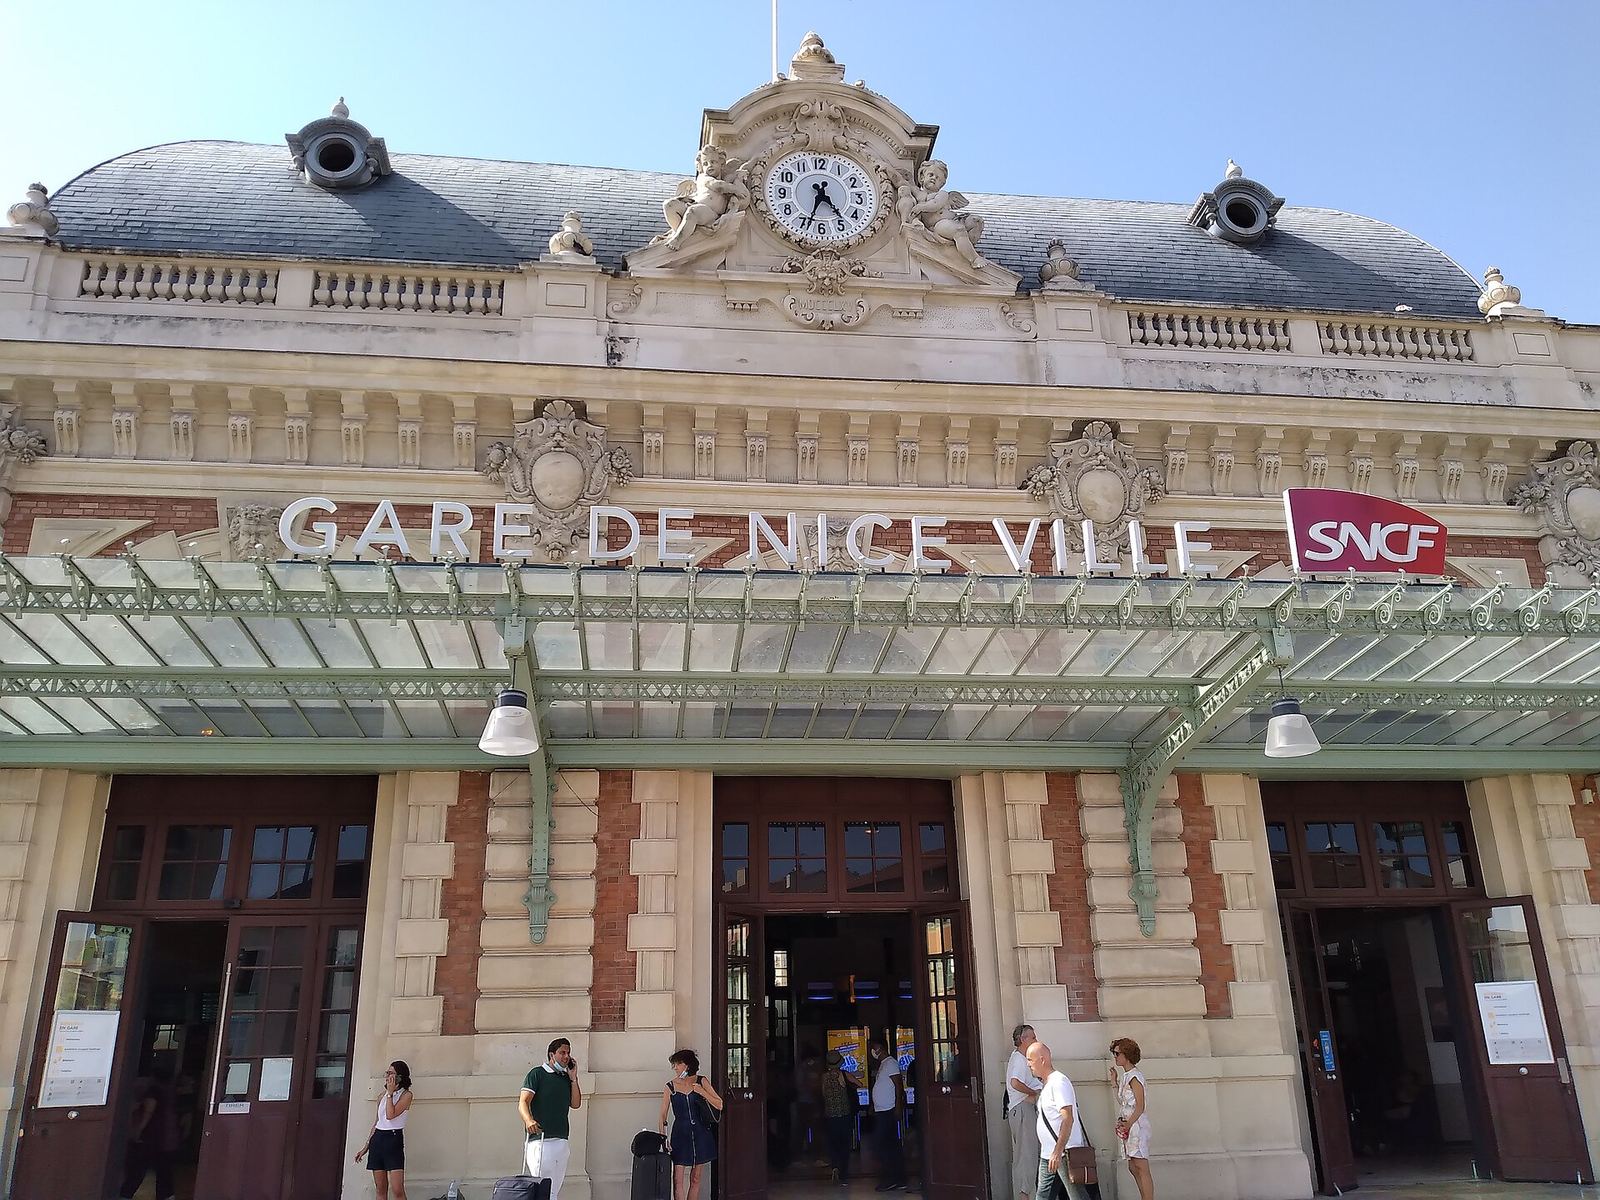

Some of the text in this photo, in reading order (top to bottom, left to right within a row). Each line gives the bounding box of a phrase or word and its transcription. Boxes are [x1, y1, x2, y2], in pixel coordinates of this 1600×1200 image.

[797, 162, 806, 172] 11
[814, 158, 826, 170] 12
[781, 172, 793, 183] 10
[849, 177, 858, 188] 2
[778, 188, 786, 199] 9
[855, 193, 863, 205] 3
[783, 204, 792, 215] 8
[850, 209, 858, 220] 4
[799, 217, 807, 228] 7
[837, 220, 845, 231] 5
[818, 223, 826, 235] 6
[279, 497, 1219, 574] GARE DE NICE VILLE
[1304, 521, 1439, 563] SNCF
